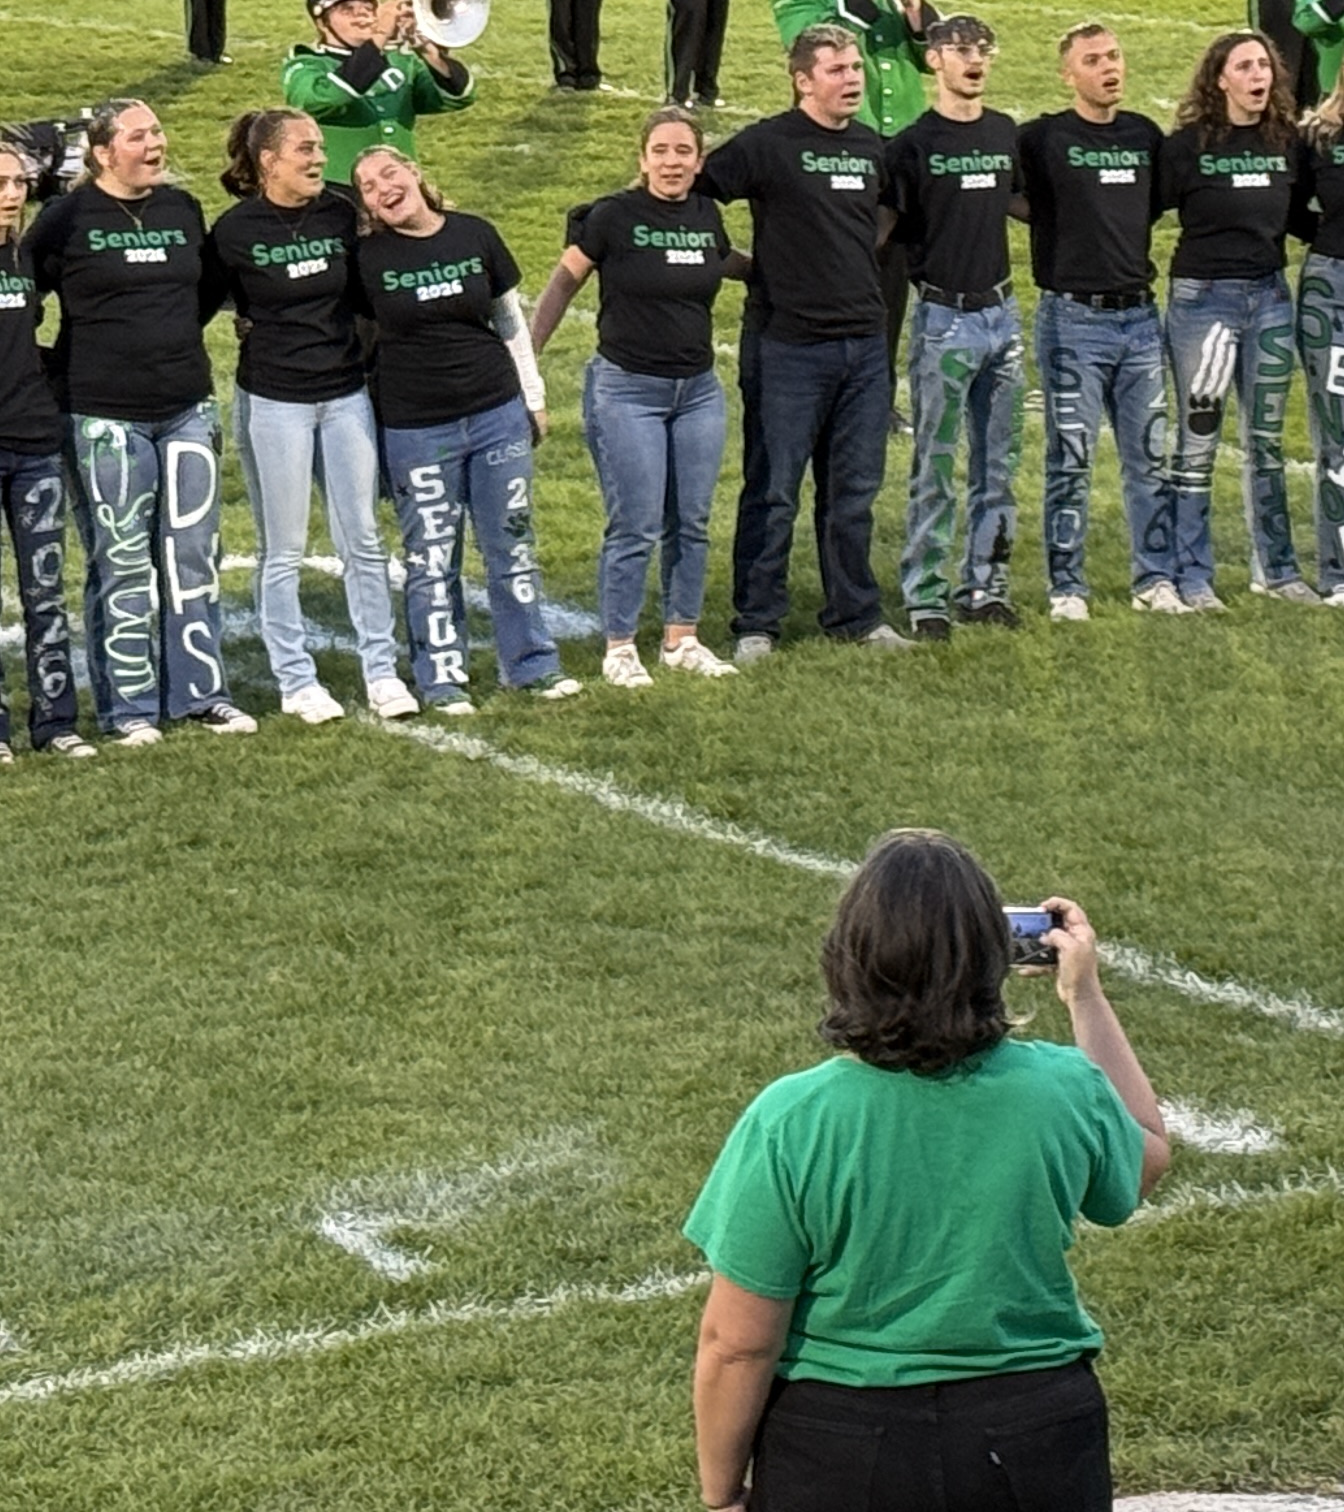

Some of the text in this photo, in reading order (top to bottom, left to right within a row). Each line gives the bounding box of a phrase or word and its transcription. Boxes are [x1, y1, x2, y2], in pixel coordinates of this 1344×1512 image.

[382, 67, 406, 92] D
[928, 148, 1013, 176] Seniors
[1067, 144, 1151, 169] Seniors
[1198, 150, 1289, 176] Seniors
[87, 222, 188, 251] Seniors
[251, 234, 347, 267] Seniors
[382, 255, 484, 292] Seniors
[415, 279, 464, 302] 2026
[166, 440, 223, 699] DHS
[409, 464, 470, 685] SENIOR
[25, 476, 72, 699] 2026
